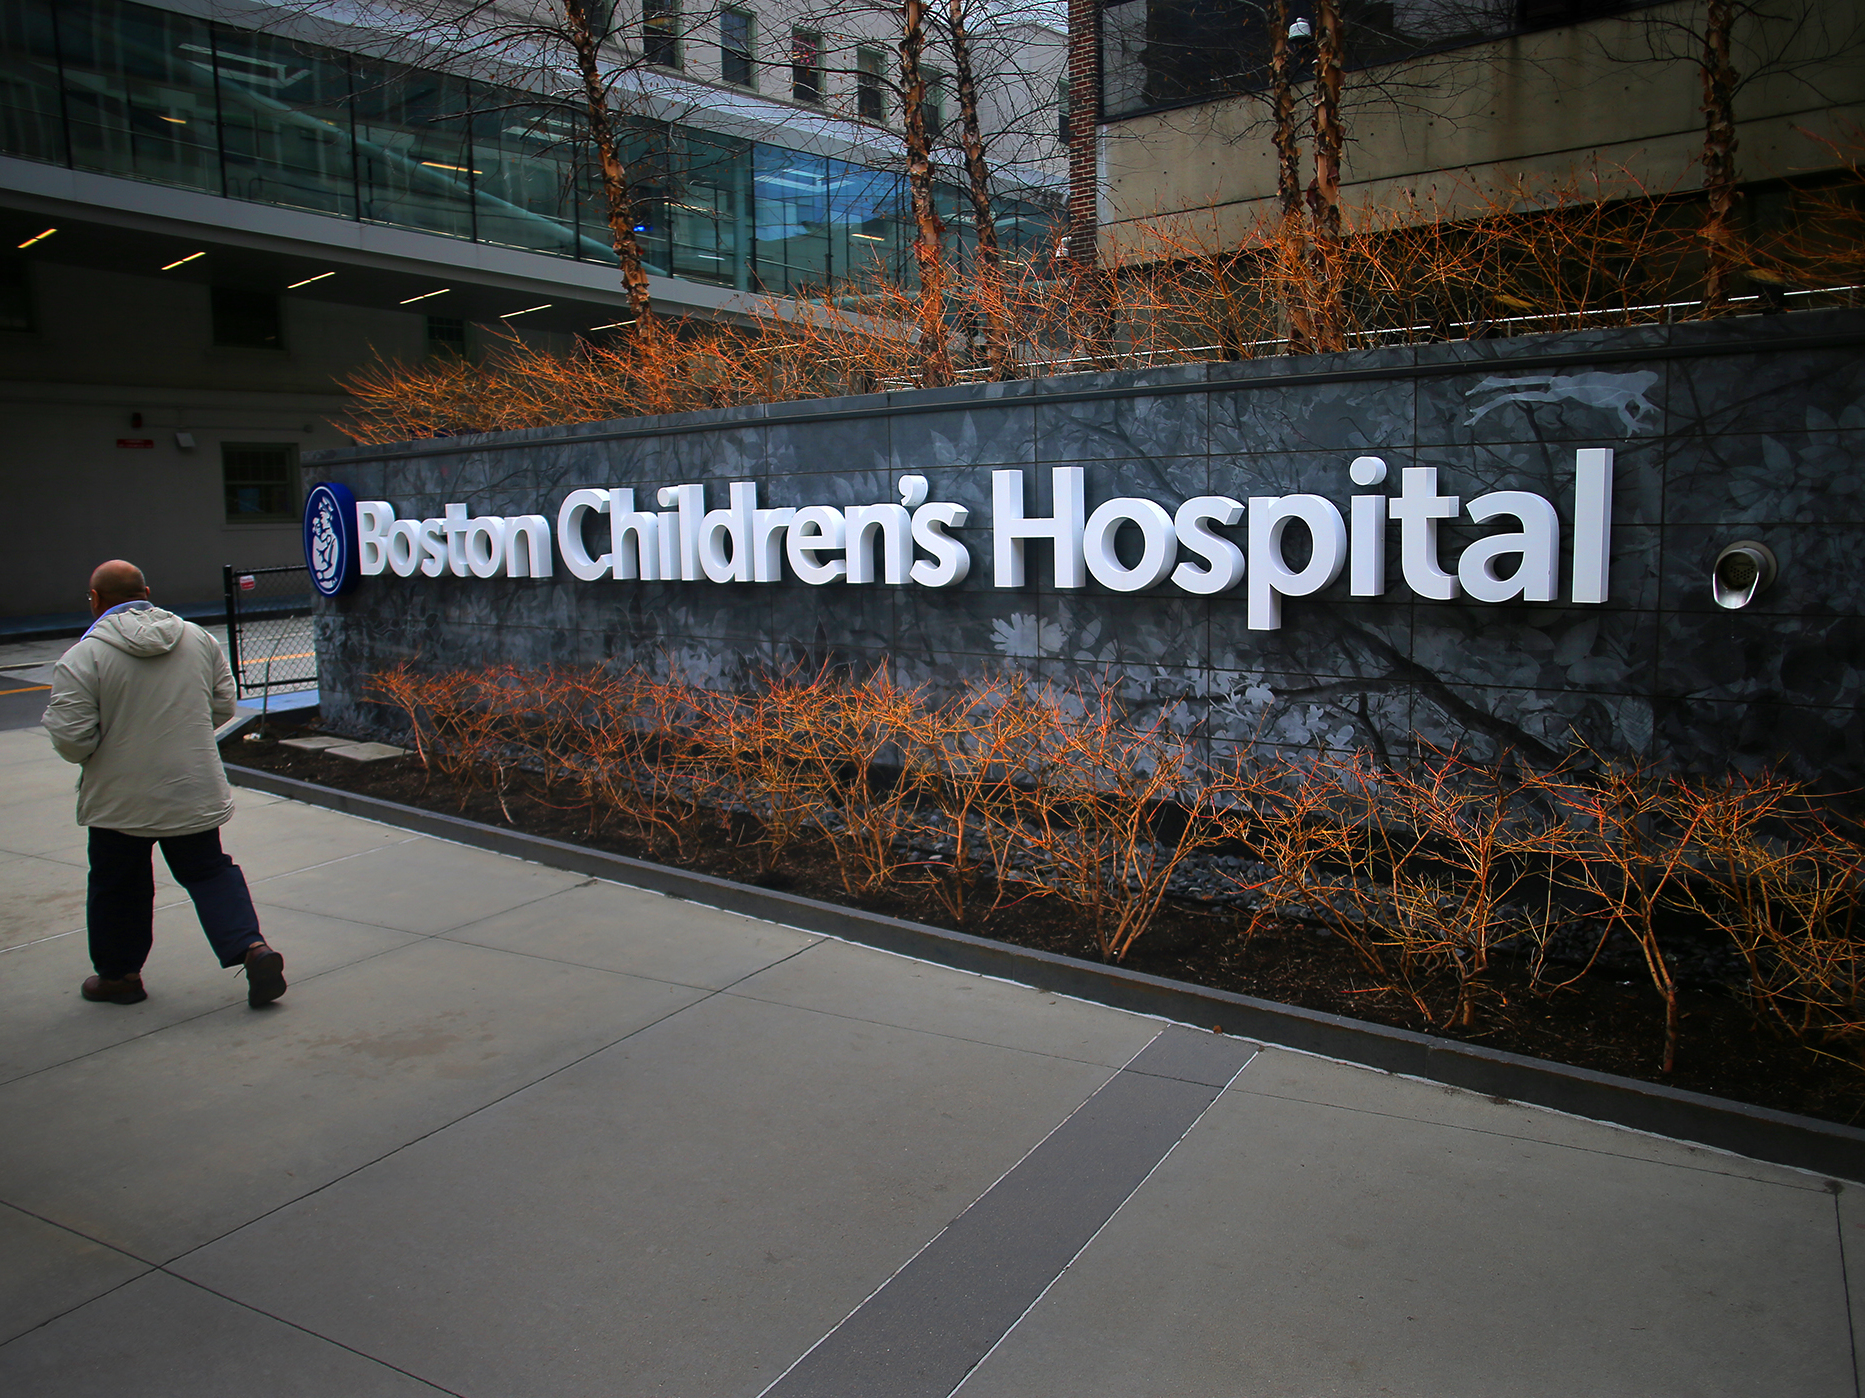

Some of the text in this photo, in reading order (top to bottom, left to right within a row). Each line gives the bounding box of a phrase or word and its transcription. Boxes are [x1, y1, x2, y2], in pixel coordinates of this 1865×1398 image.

[356, 448, 1613, 630] Boston Children's Hospital
